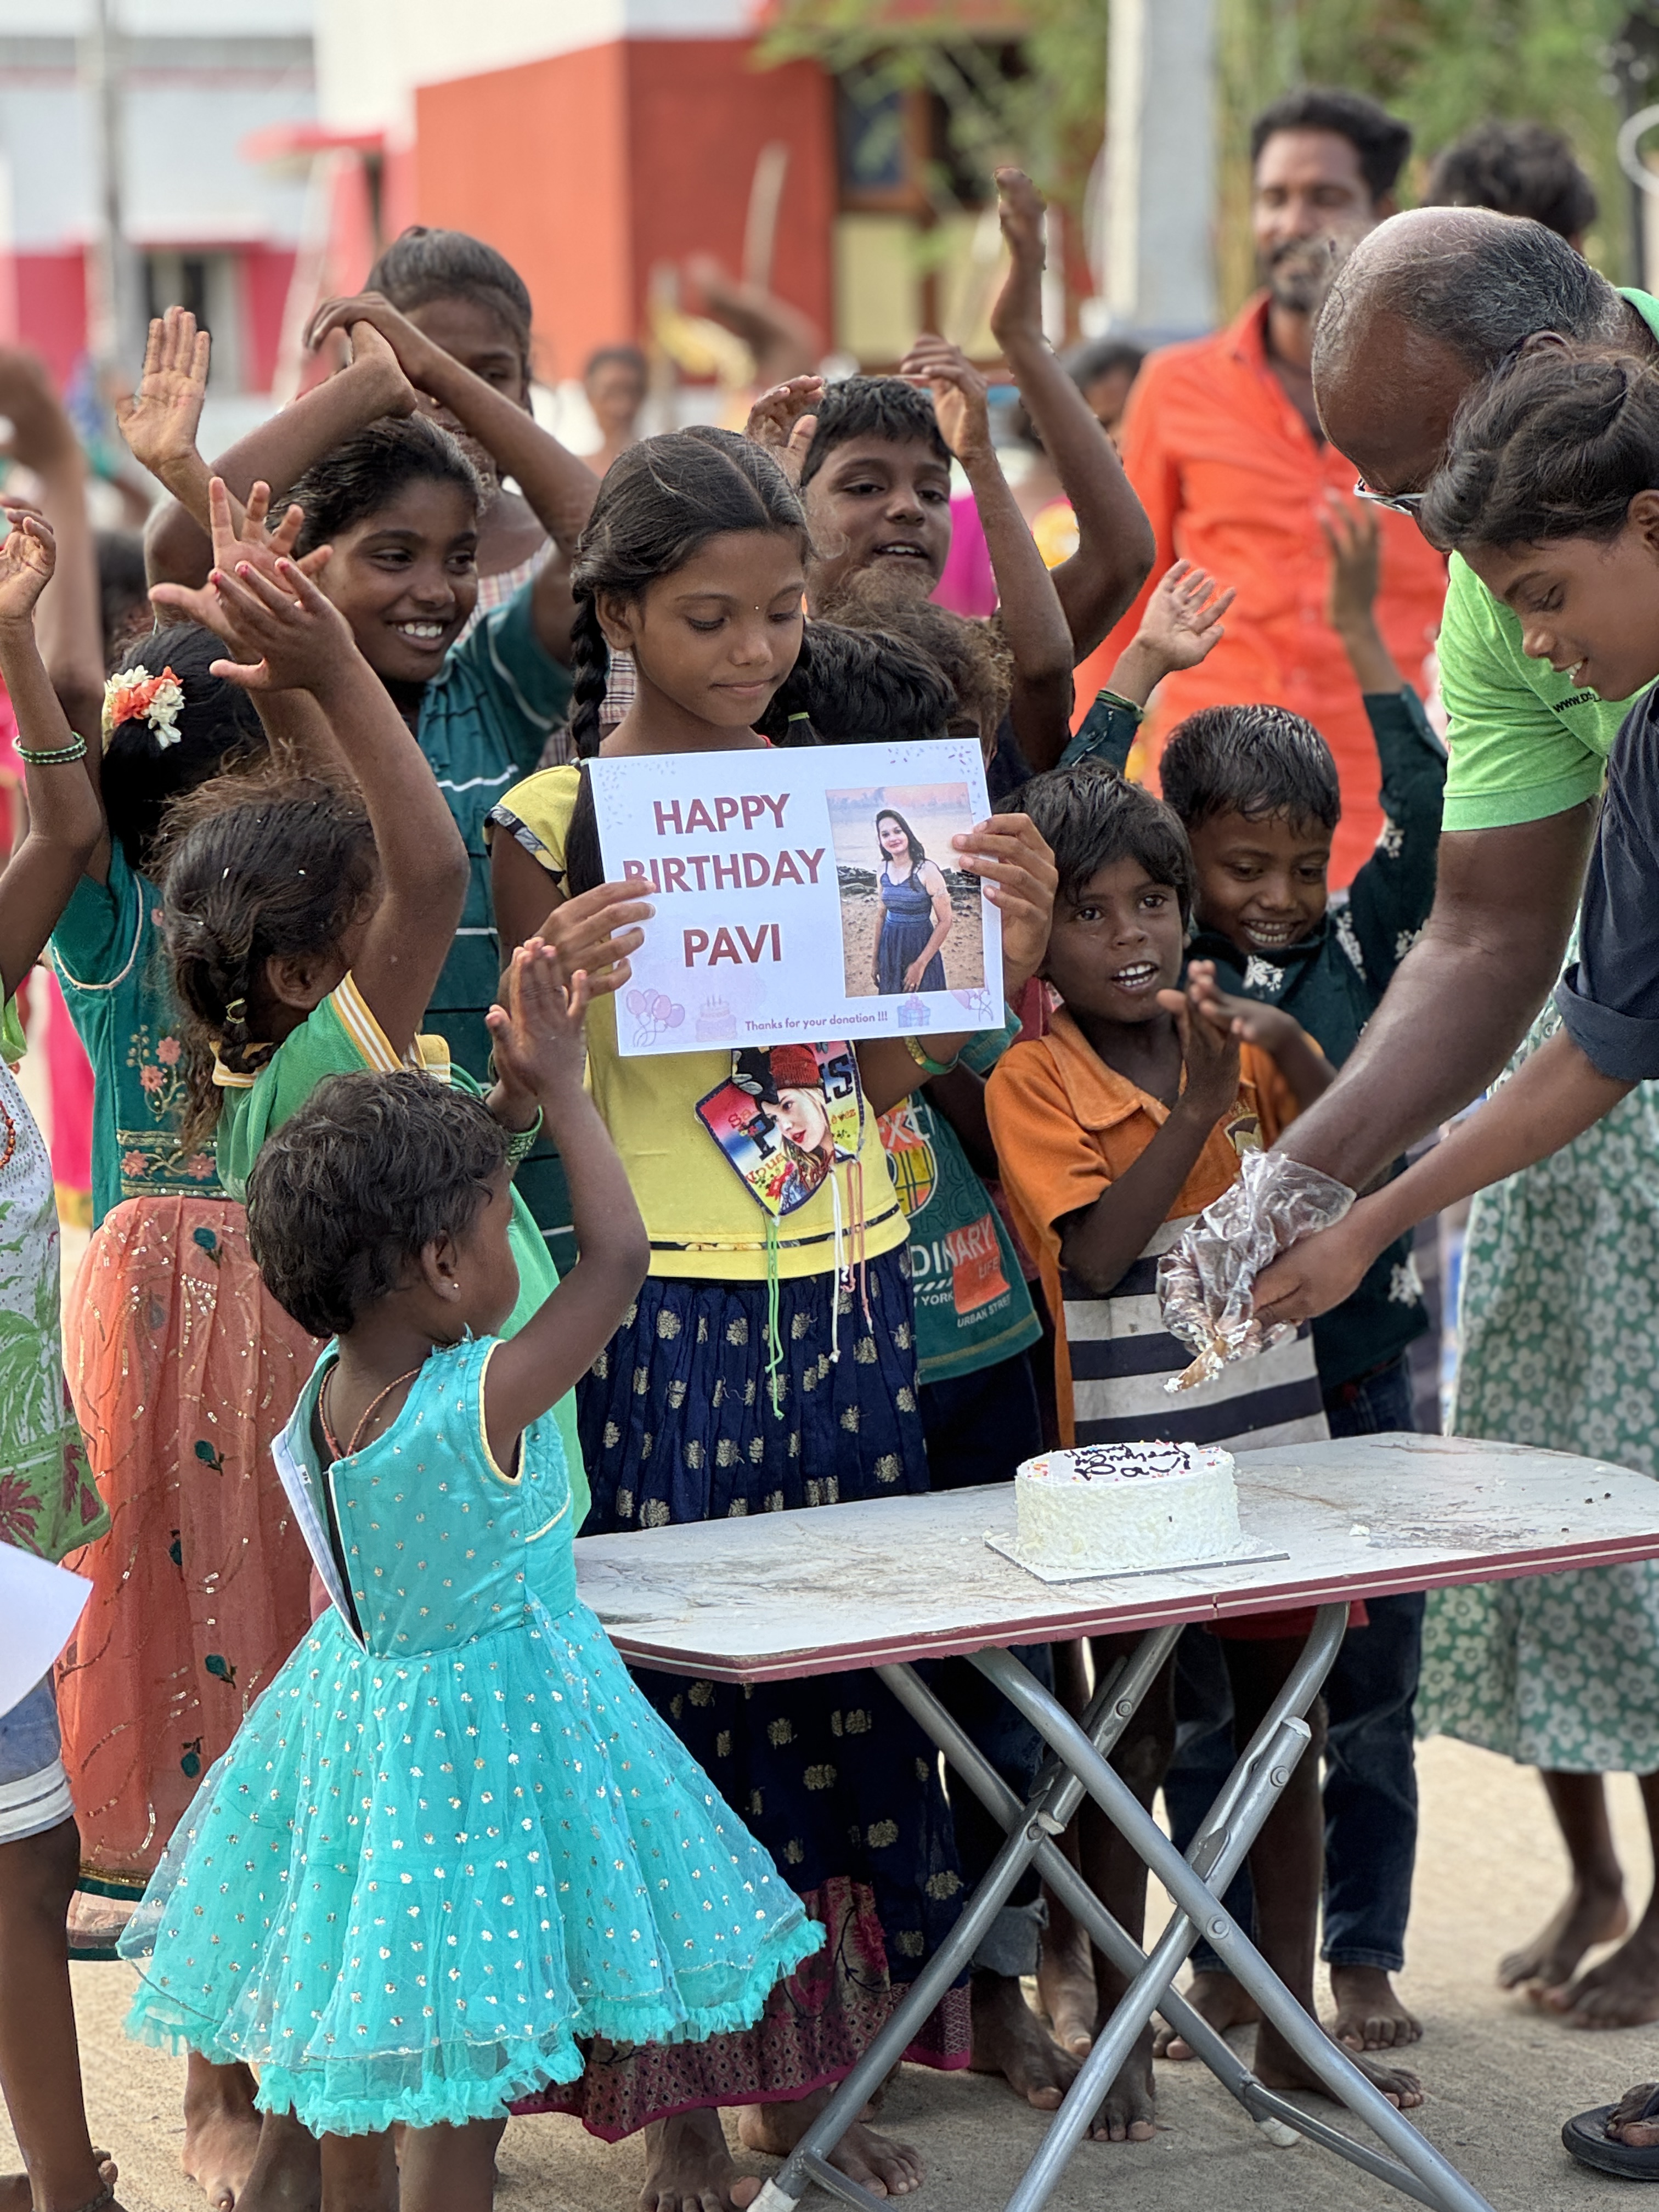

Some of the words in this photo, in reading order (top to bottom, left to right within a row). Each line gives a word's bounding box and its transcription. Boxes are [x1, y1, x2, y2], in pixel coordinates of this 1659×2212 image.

[653, 793, 791, 835] HAPPY
[623, 848, 826, 894] BIRTHDAY
[683, 924, 781, 967] PAVI
[745, 1019, 782, 1031] Thanks
[785, 1018, 800, 1029] for
[803, 1019, 827, 1030] your
[830, 1013, 876, 1025] donation
[910, 1214, 993, 1277] DINARY
[921, 1291, 953, 1306] YORK
[957, 1308, 988, 1328] URBAN
